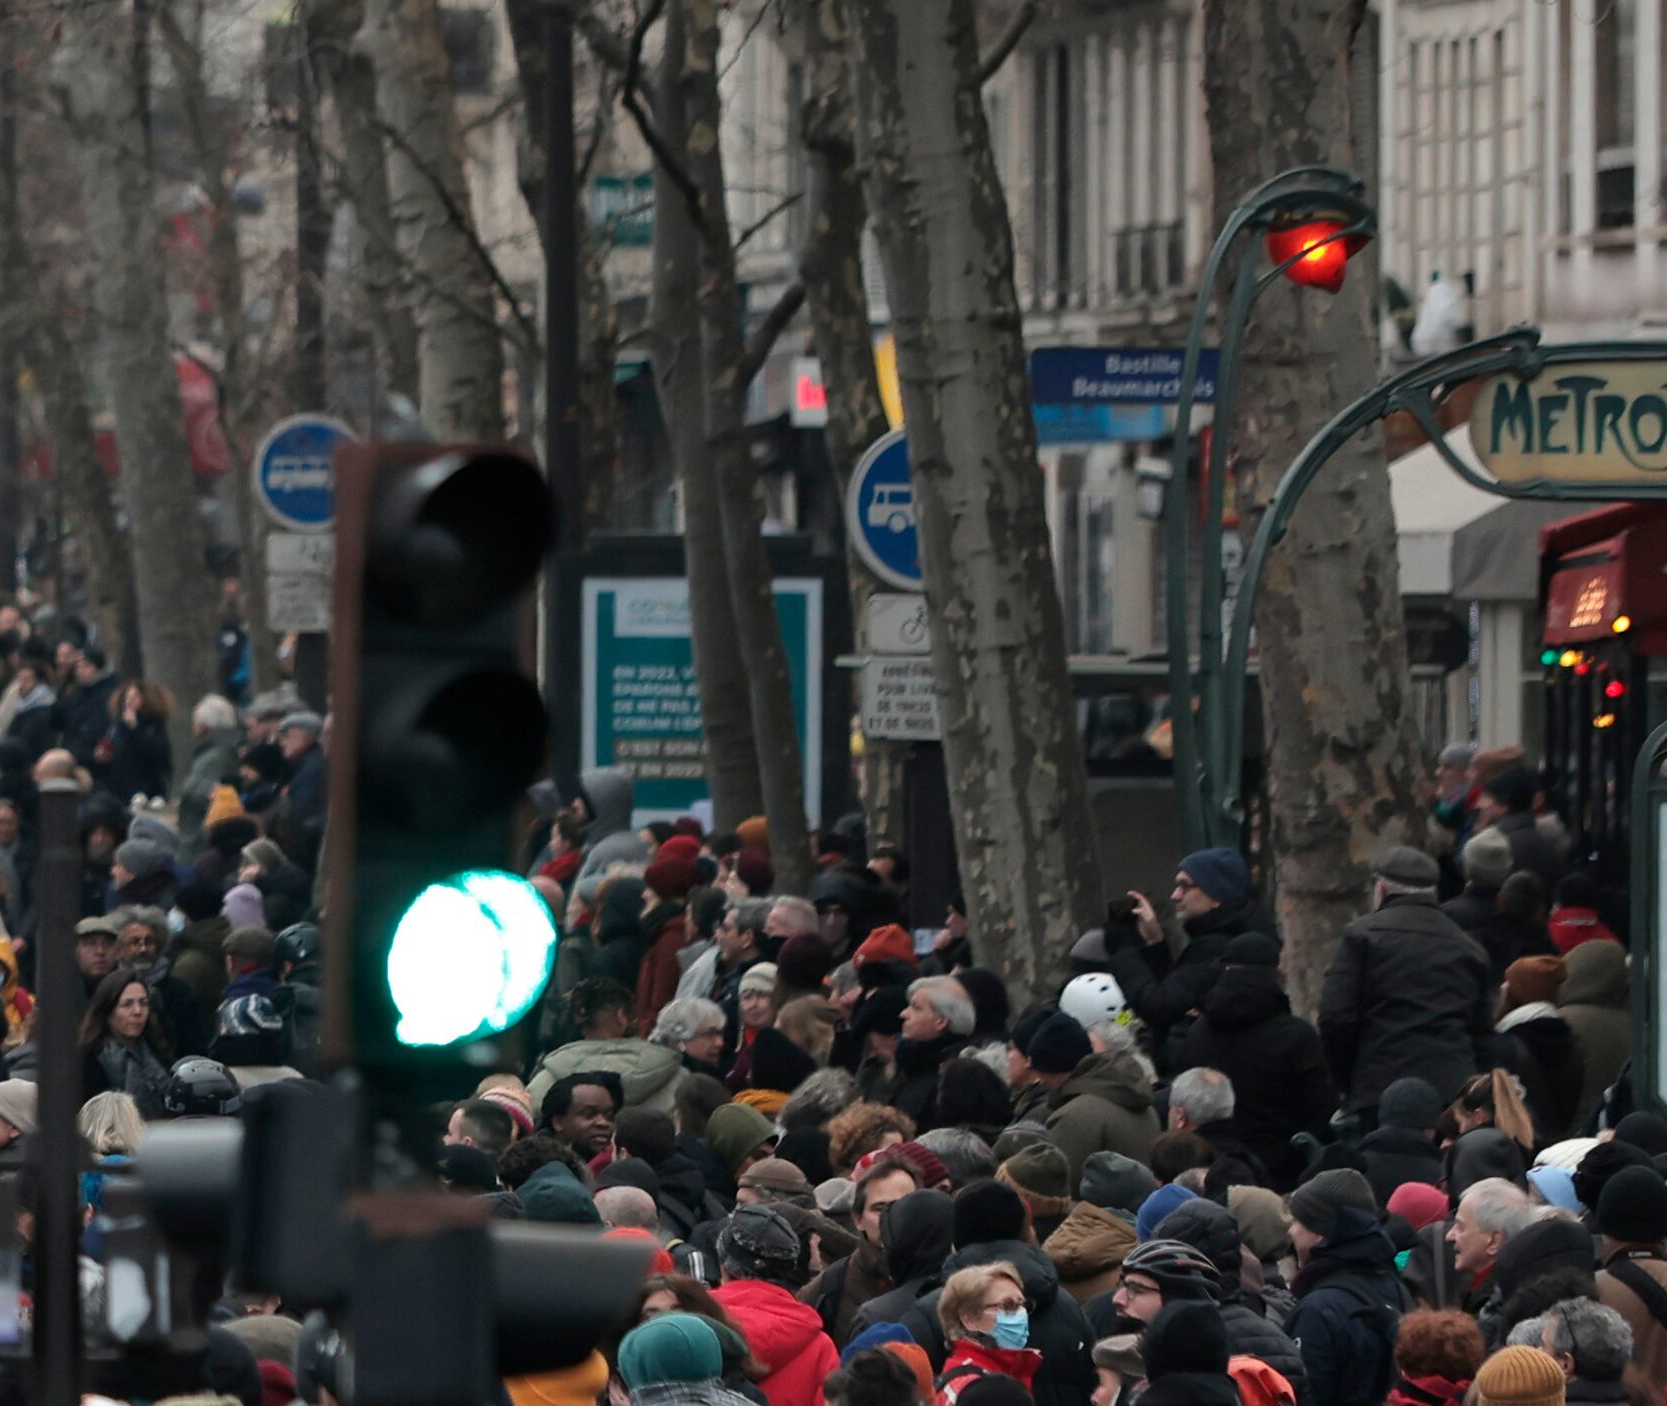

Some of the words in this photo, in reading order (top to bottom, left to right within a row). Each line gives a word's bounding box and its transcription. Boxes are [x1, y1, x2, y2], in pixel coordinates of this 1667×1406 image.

[1105, 354, 1181, 374] Bastille
[1071, 375, 1215, 398] Beaumarchis
[1489, 375, 1667, 472] METRO
